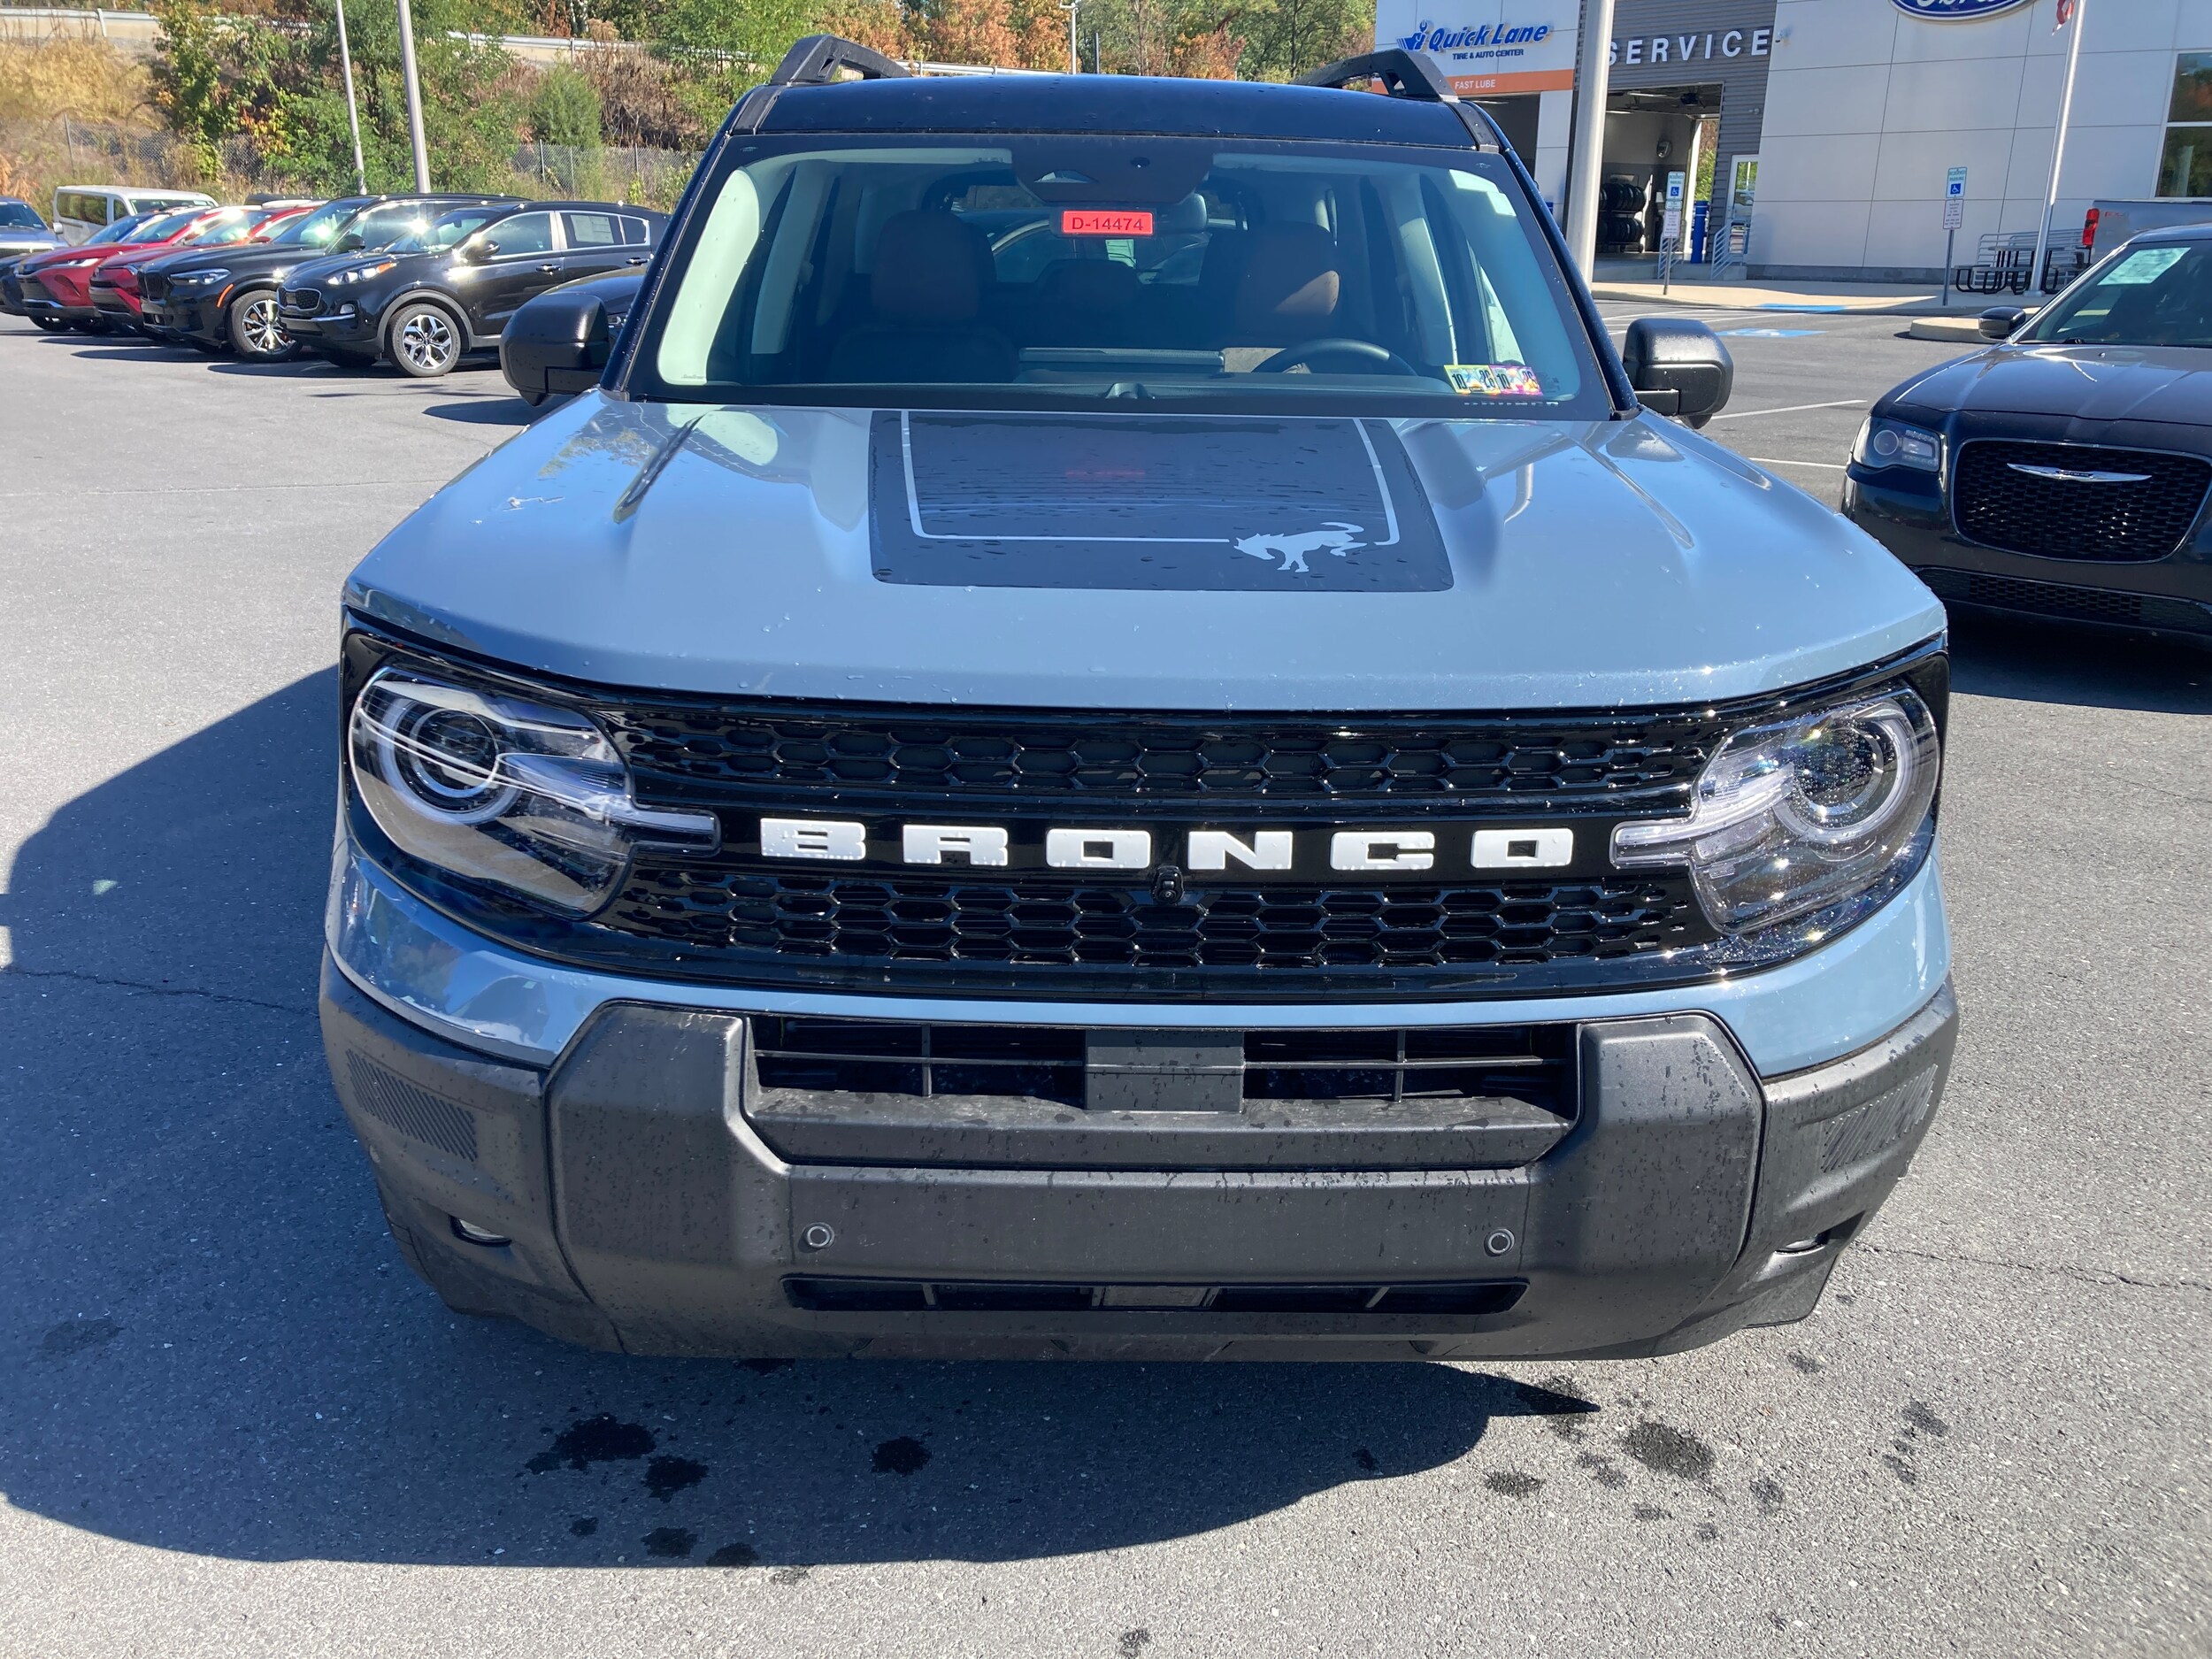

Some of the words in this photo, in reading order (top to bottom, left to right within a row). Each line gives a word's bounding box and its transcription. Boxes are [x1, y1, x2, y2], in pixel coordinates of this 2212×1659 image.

[1428, 25, 1491, 51] Quick
[1491, 23, 1548, 45] Lane
[1475, 50, 1494, 59] AUTO
[1495, 49, 1524, 58] CENTER
[1455, 81, 1474, 89] FAST
[1475, 80, 1496, 88] LUBE
[1071, 217, 1144, 231] D-14474
[1451, 373, 1468, 389] 10
[760, 818, 1574, 872] BRONCO
